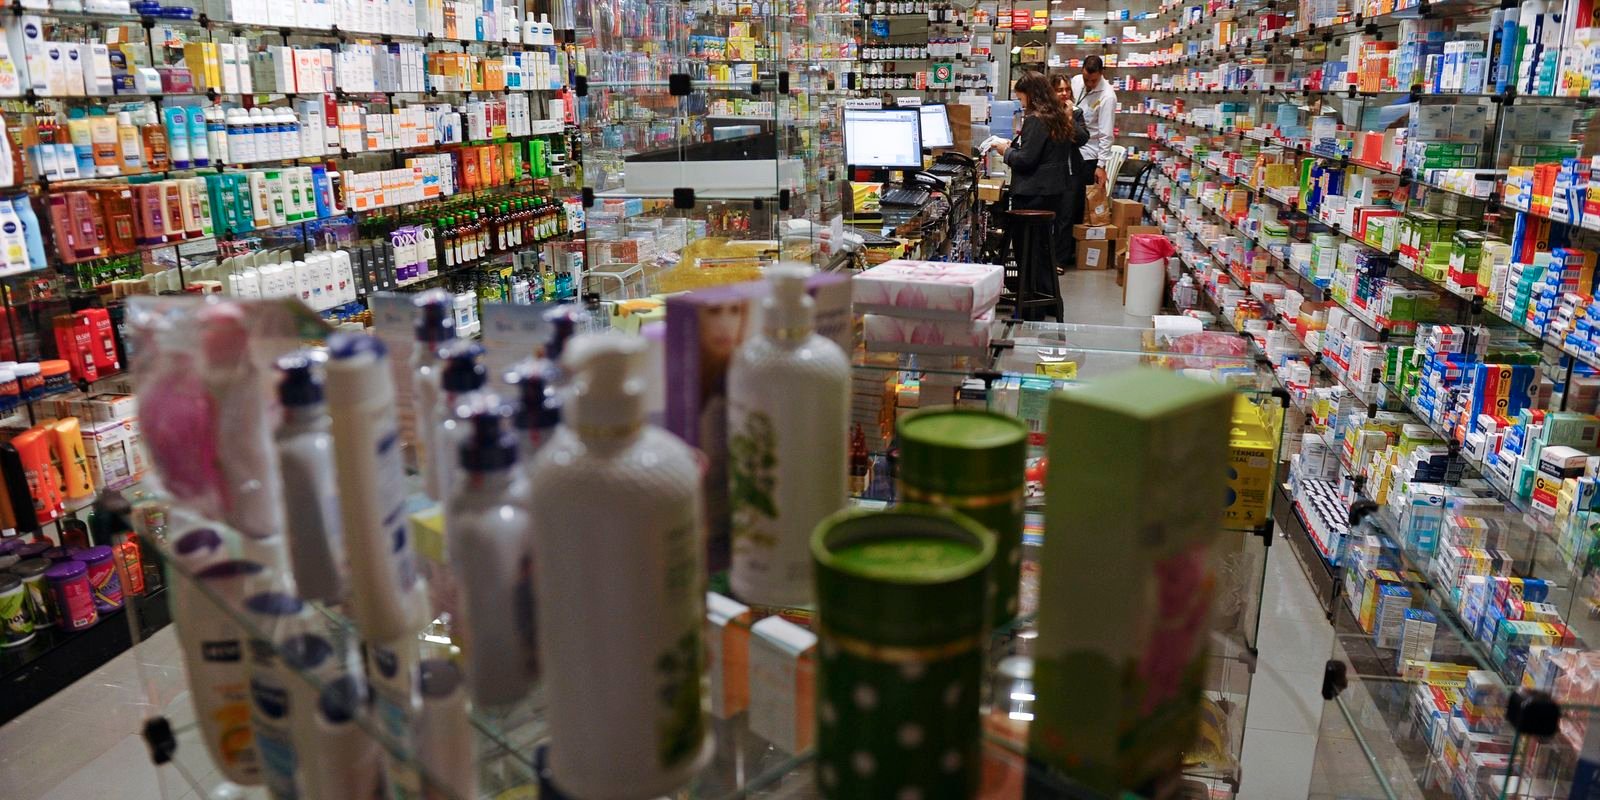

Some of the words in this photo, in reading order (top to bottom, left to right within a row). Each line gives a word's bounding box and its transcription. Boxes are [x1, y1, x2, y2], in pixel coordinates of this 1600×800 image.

[1501, 370, 1511, 379] G
[1497, 399, 1508, 408] G
[1536, 478, 1545, 489] G
